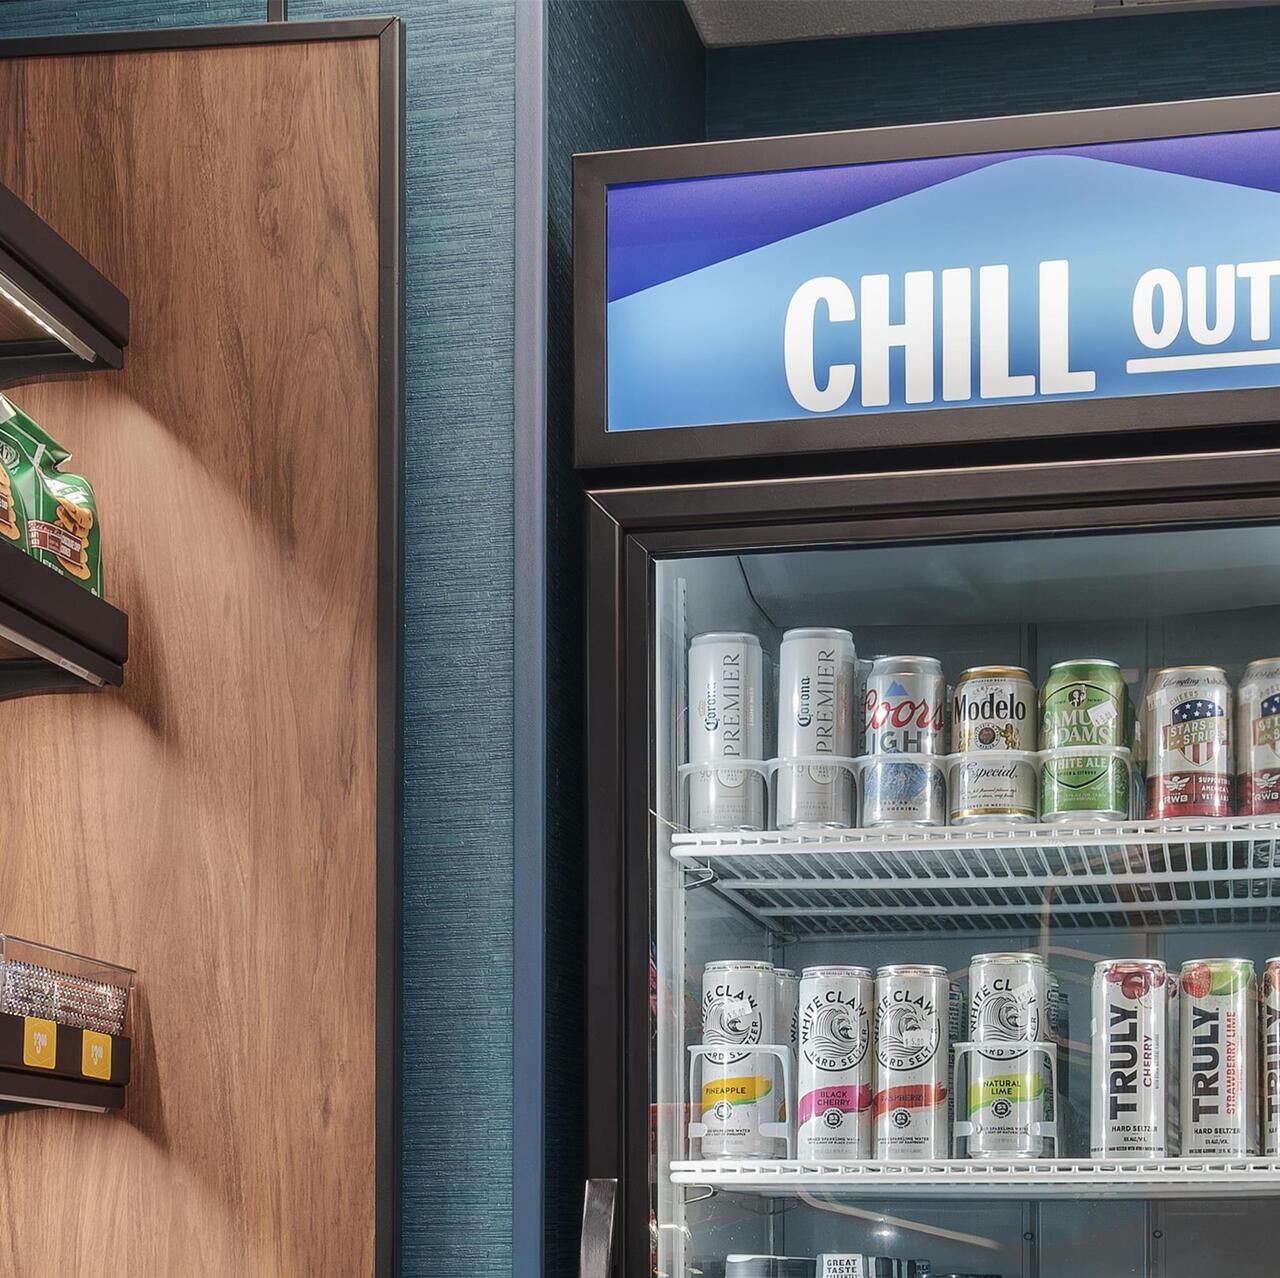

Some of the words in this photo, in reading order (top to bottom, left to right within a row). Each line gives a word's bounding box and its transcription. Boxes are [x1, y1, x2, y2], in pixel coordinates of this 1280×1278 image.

[784, 259, 1096, 412] CHILL
[722, 652, 741, 758] PREMIER
[816, 648, 834, 753] PREMIER
[862, 689, 944, 732] Coors
[954, 693, 1026, 721] Modelo
[1049, 757, 1084, 770] WHITE
[1086, 756, 1107, 768] ALE
[1226, 1011, 1236, 1045] LIME
[1109, 1004, 1138, 1121] TRULY
[1142, 1034, 1153, 1088] CHERRY
[1191, 1007, 1220, 1123] TRULY
[983, 1080, 1022, 1088] NATURAL
[990, 1087, 1013, 1096] LIME
[1226, 1047, 1236, 1114] STRAWBERRY
[817, 1098, 851, 1106] CHERRY
[826, 1258, 858, 1267] GREAT
[826, 1266, 858, 1274] TASTE
